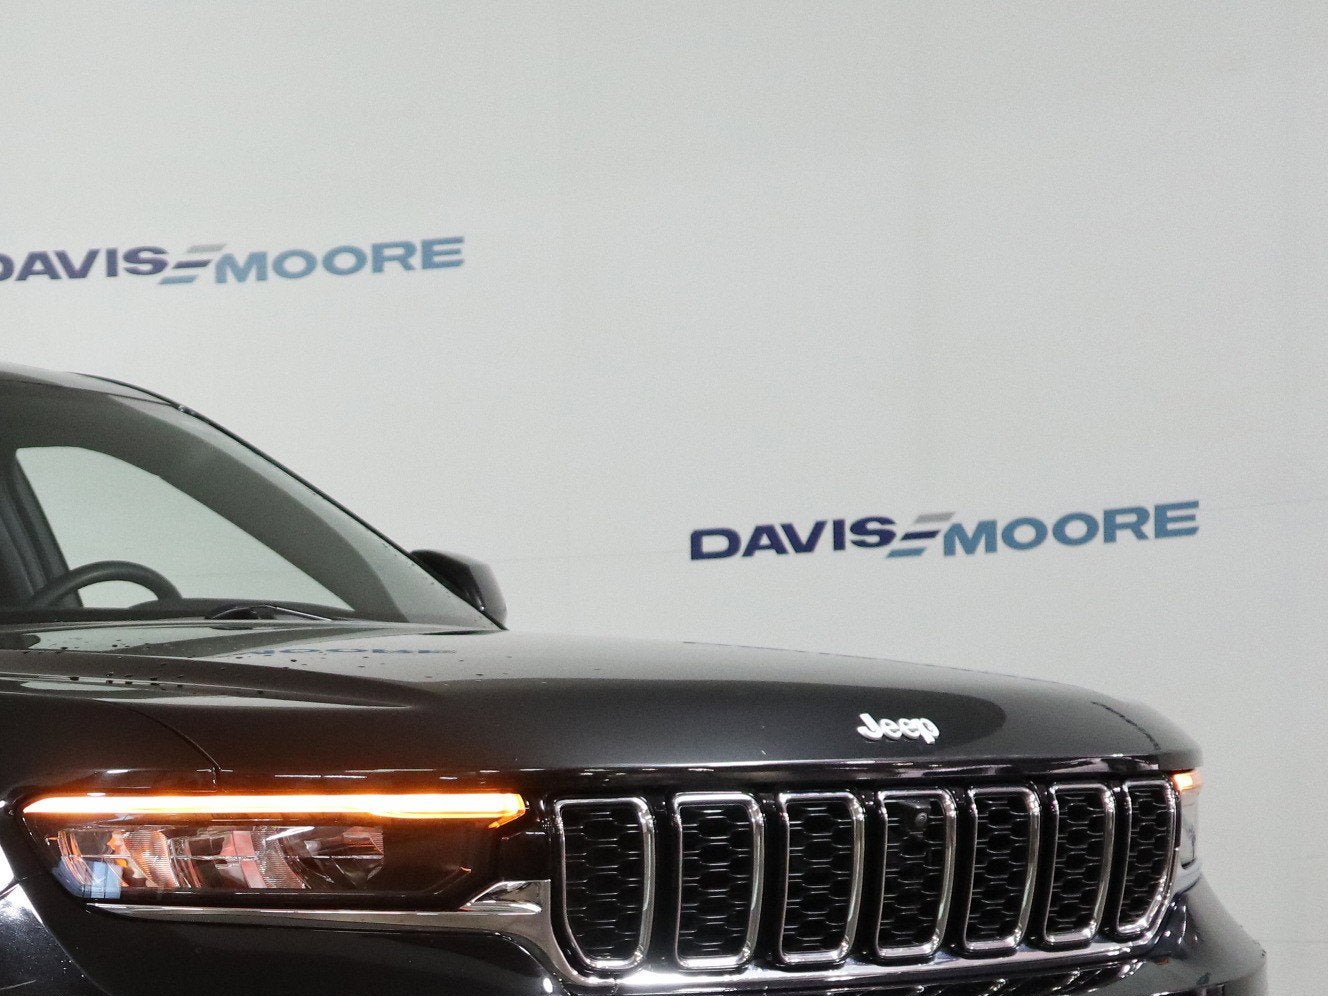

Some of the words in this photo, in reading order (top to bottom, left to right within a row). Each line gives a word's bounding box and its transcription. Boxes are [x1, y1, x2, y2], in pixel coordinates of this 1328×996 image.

[215, 236, 466, 285] MOORE
[690, 515, 898, 561] DAVIS
[943, 500, 1201, 558] MOORE
[856, 712, 941, 744] Jeep
